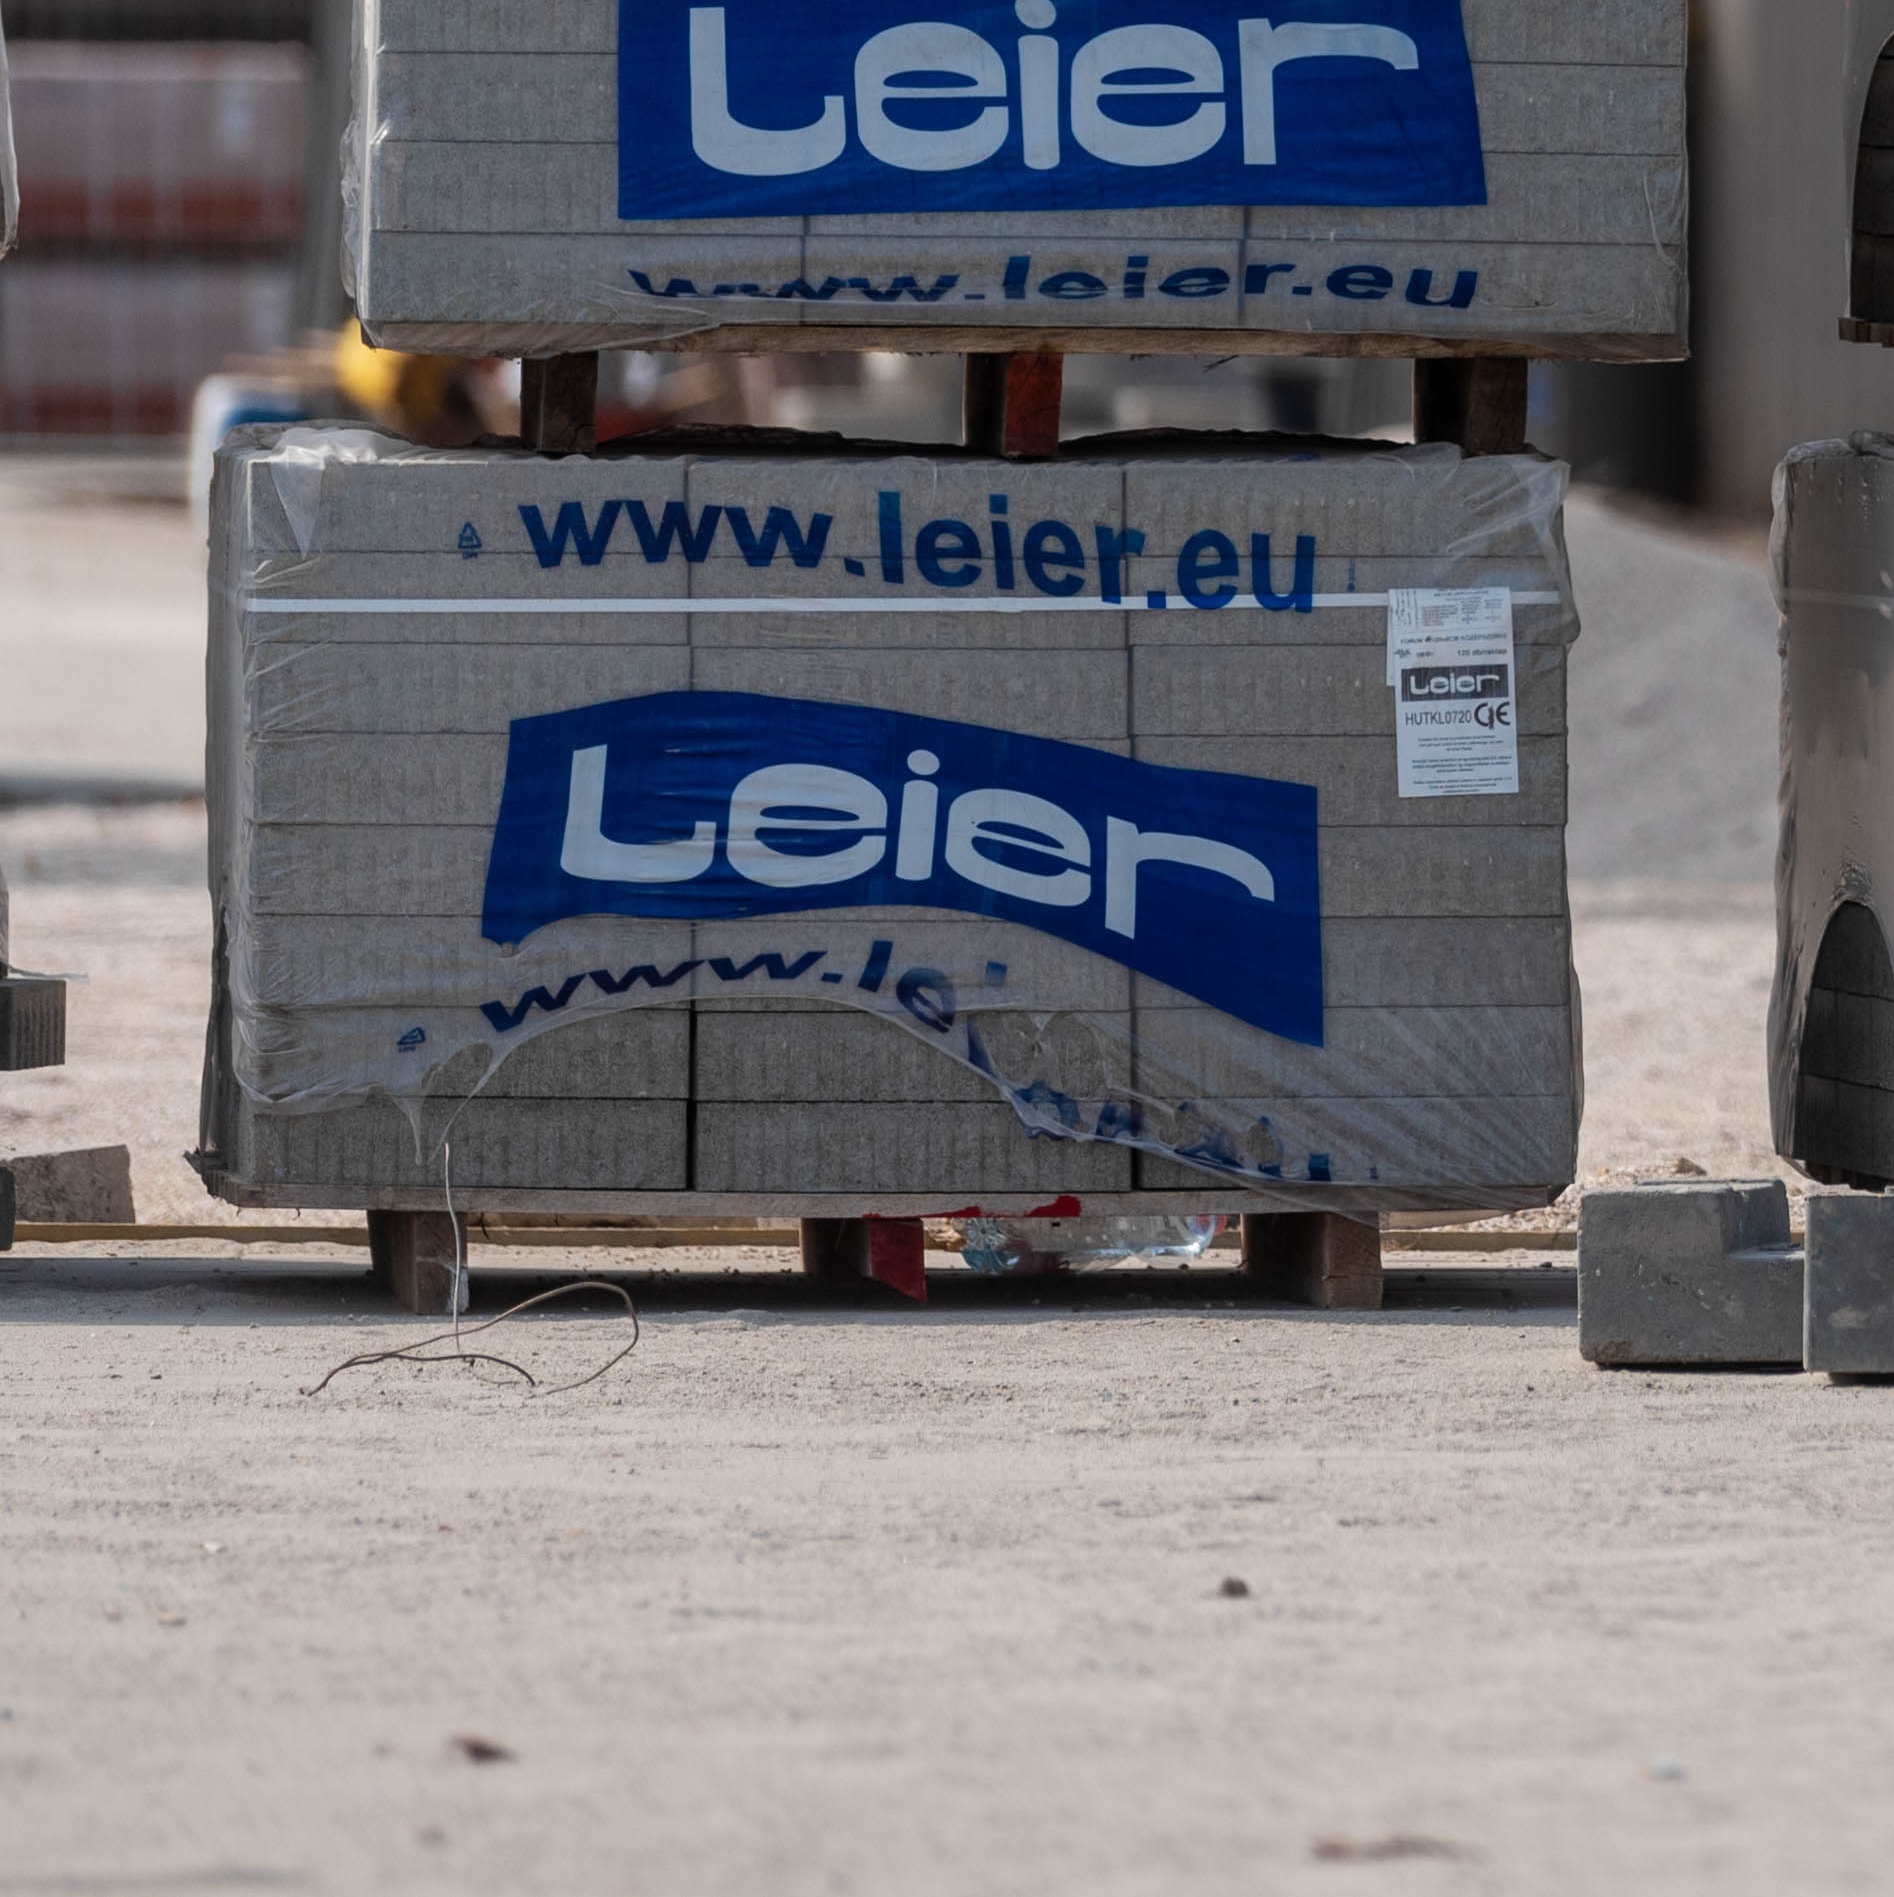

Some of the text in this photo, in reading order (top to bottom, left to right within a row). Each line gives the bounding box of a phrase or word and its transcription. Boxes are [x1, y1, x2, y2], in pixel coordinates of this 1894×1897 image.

[518, 490, 1317, 614] www.leier.eu
[1404, 709, 1472, 726] HUTKL0720
[1409, 672, 1500, 695] Leier
[559, 749, 1276, 940] Leier
